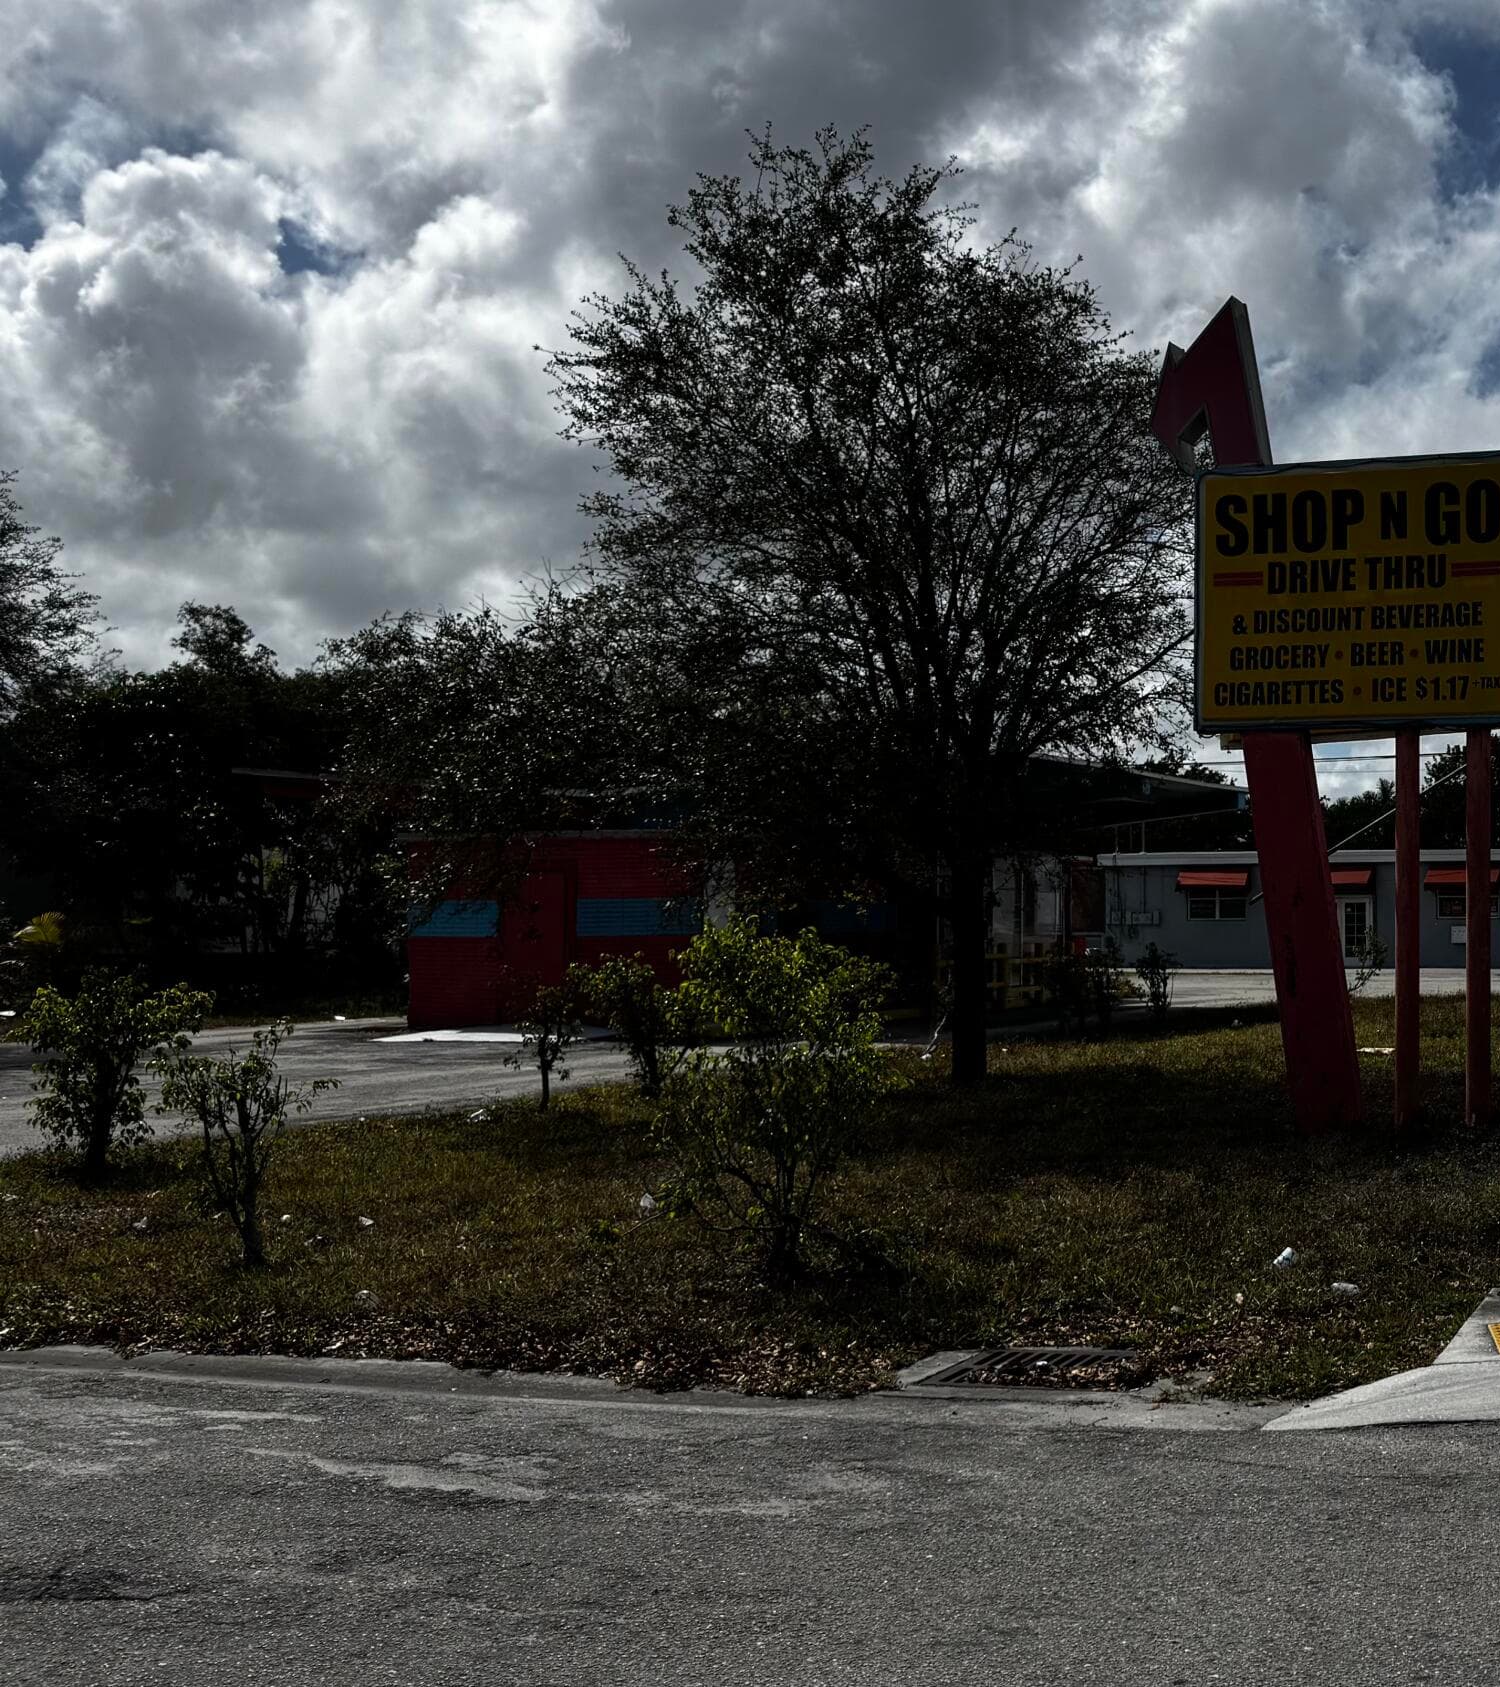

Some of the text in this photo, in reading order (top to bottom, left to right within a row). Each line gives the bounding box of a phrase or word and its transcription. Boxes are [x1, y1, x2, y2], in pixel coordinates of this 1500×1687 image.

[1215, 489, 1364, 556] SHOP
[1381, 491, 1408, 540] N
[1267, 554, 1447, 595] DRIVE THRU
[1232, 602, 1483, 635] & DISCOUNT BEVERAGE
[1230, 638, 1485, 671] GROCERY BEER WINE
[1214, 679, 1344, 706] CIGARETTES
[1372, 677, 1407, 702] ICE
[1415, 676, 1470, 702] $1.17
